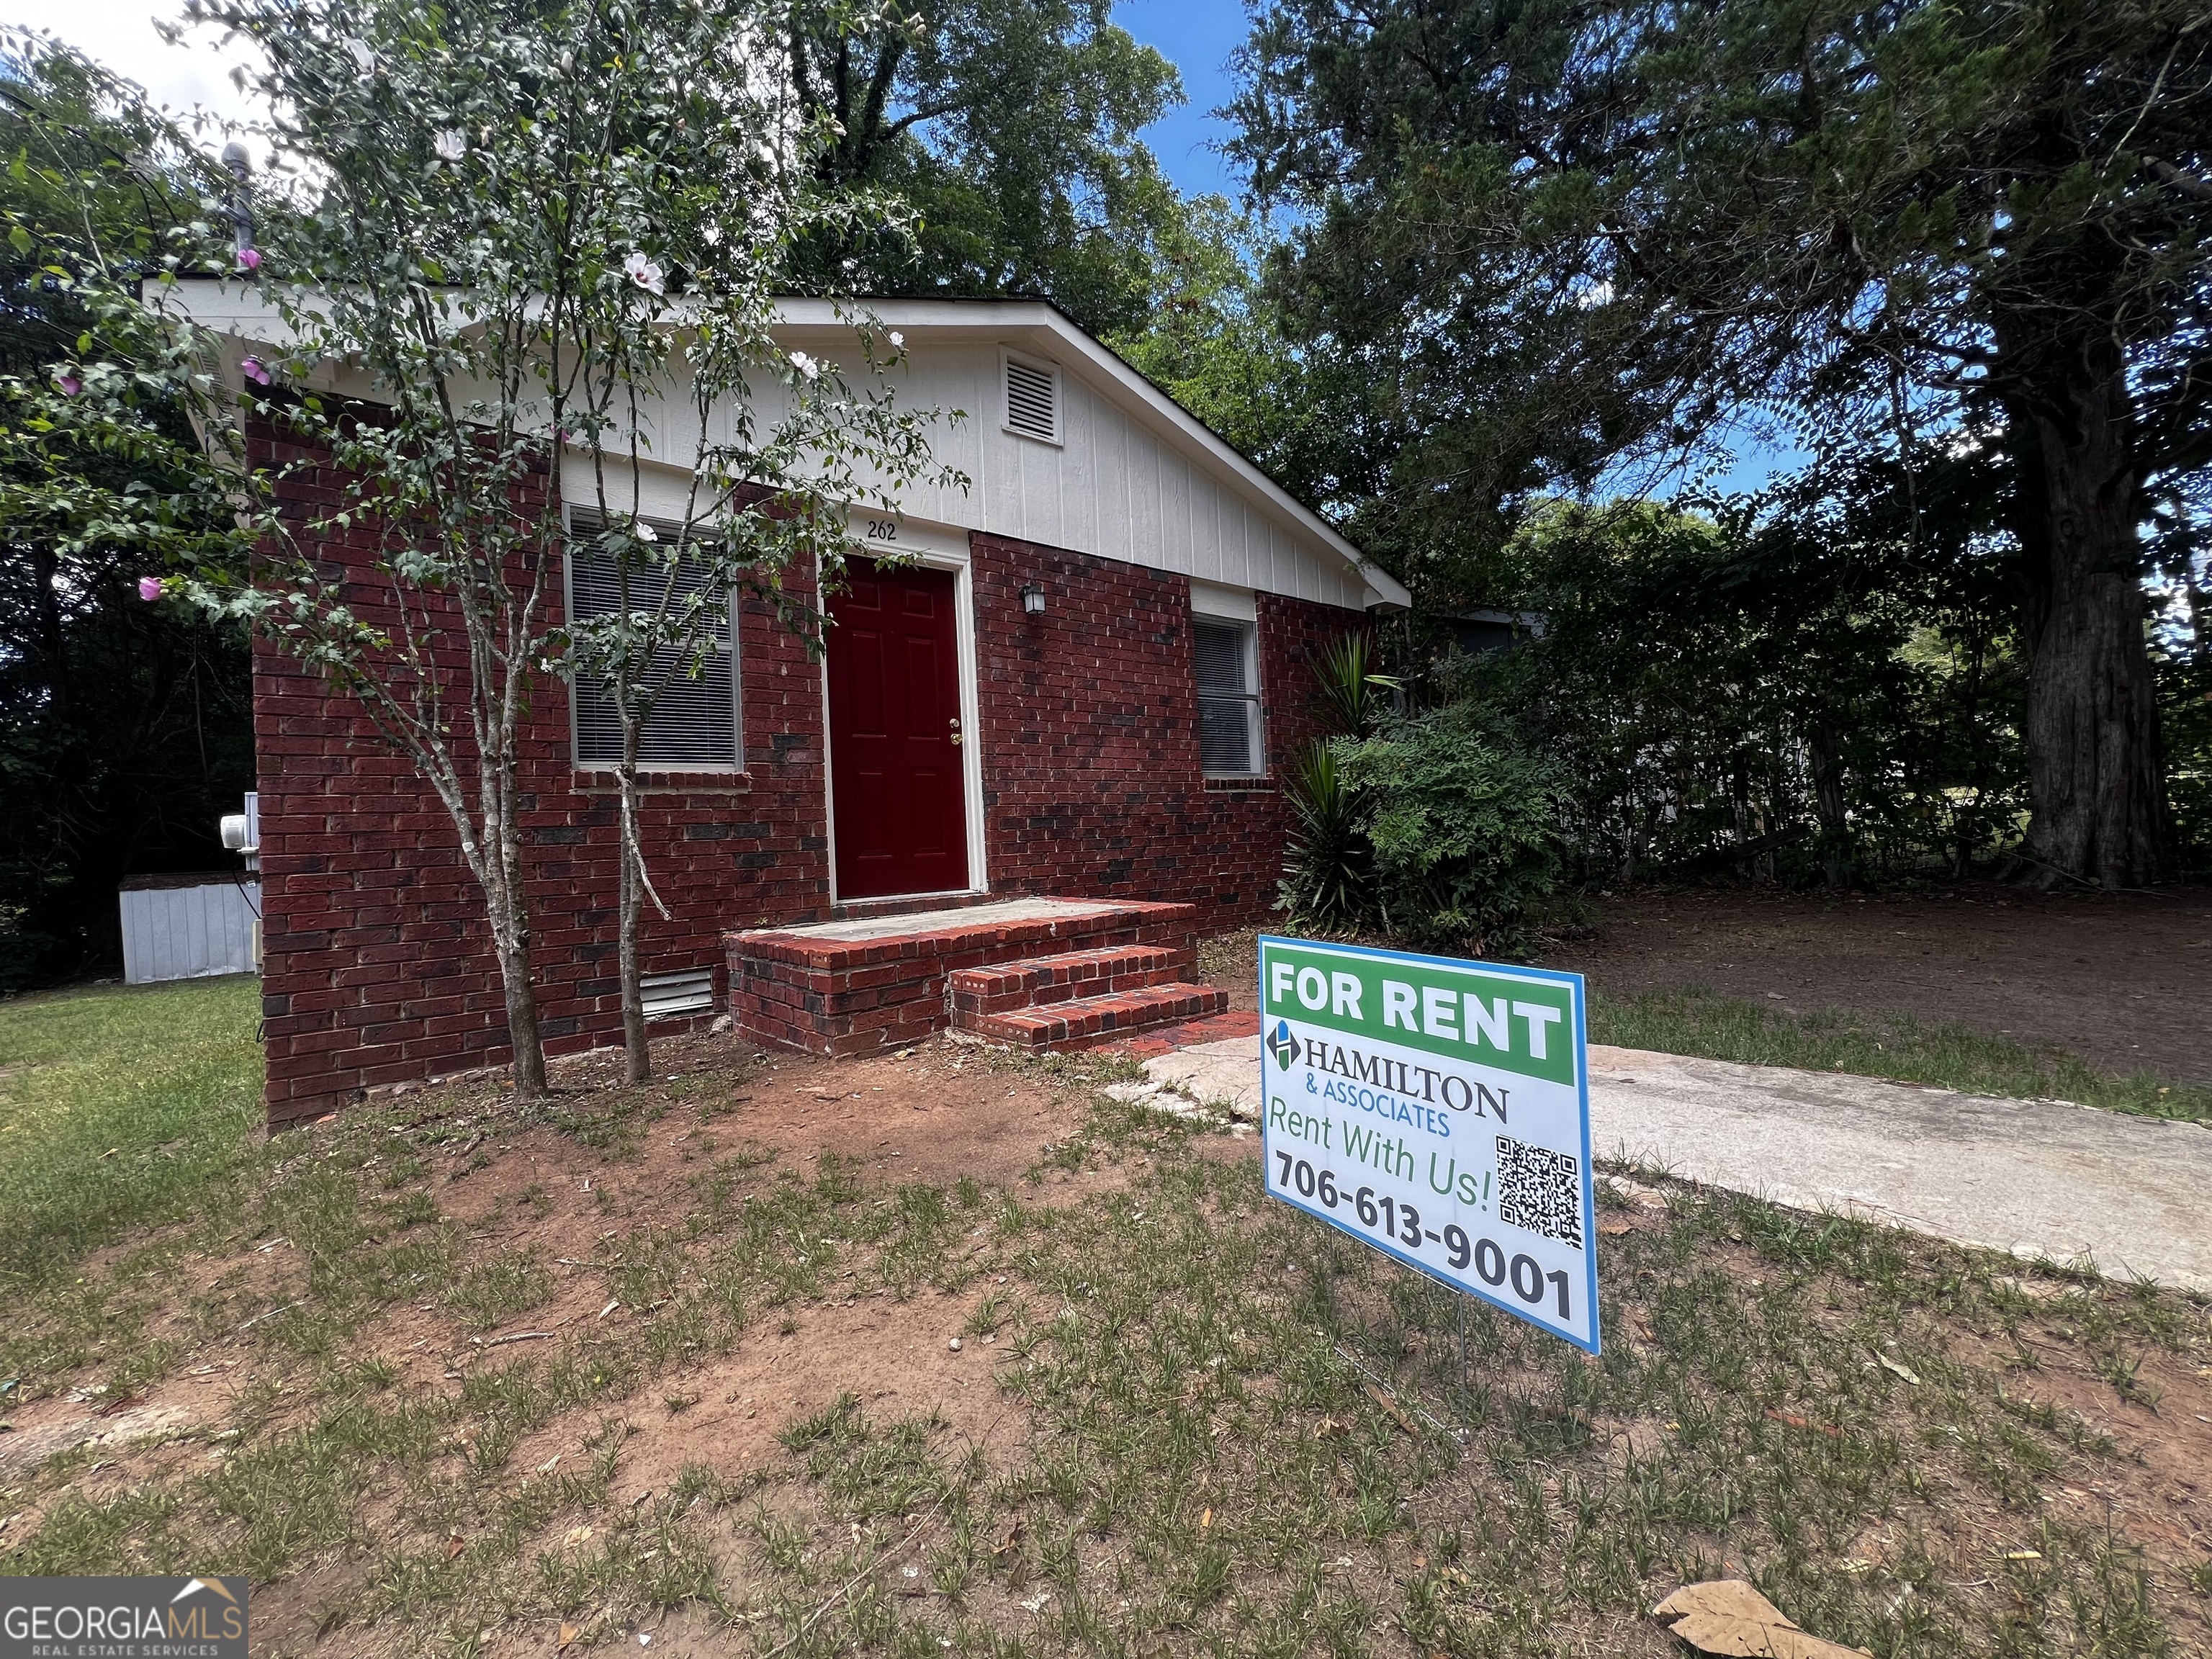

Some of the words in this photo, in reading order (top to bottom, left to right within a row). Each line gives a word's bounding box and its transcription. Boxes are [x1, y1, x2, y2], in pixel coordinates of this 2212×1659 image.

[868, 520, 896, 541] 262
[1271, 962, 1364, 1020] FOR
[1382, 979, 1561, 1060] RENT
[1305, 1038, 1510, 1125] HAMILTON
[1306, 1073, 1318, 1094] &
[1323, 1082, 1450, 1137] ASSOCIATES
[1269, 1096, 1332, 1148] Rent
[1343, 1121, 1414, 1182] With
[1430, 1152, 1491, 1212] Us!
[1276, 1150, 1570, 1321] 706-613-9001
